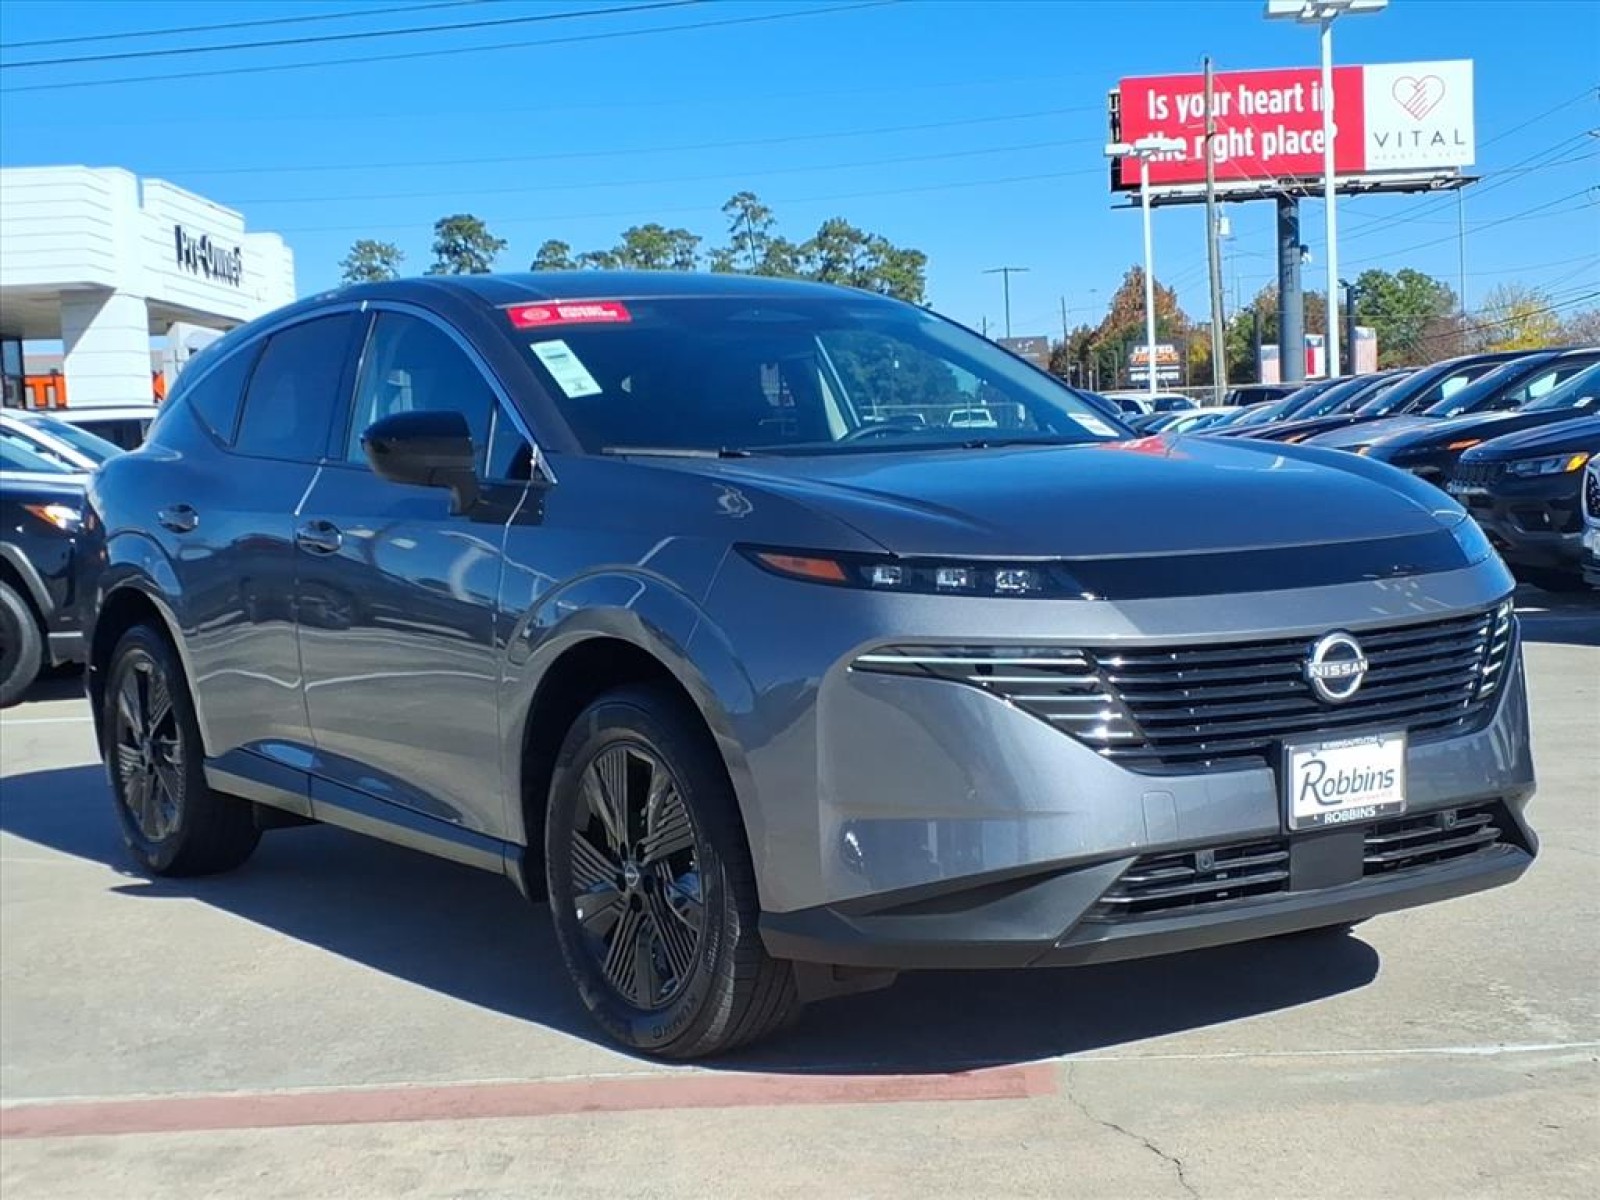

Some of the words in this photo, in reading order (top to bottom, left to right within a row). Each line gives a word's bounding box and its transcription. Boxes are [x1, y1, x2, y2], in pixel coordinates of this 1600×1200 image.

[1148, 88, 1169, 120] Is
[1175, 91, 1231, 123] your
[1239, 82, 1304, 115] heart
[1195, 126, 1255, 163] rght
[1374, 129, 1466, 147] VITAL
[1309, 659, 1367, 677] NISSAN
[1300, 759, 1395, 805] Robbins
[1325, 805, 1376, 824] ROBBINS
